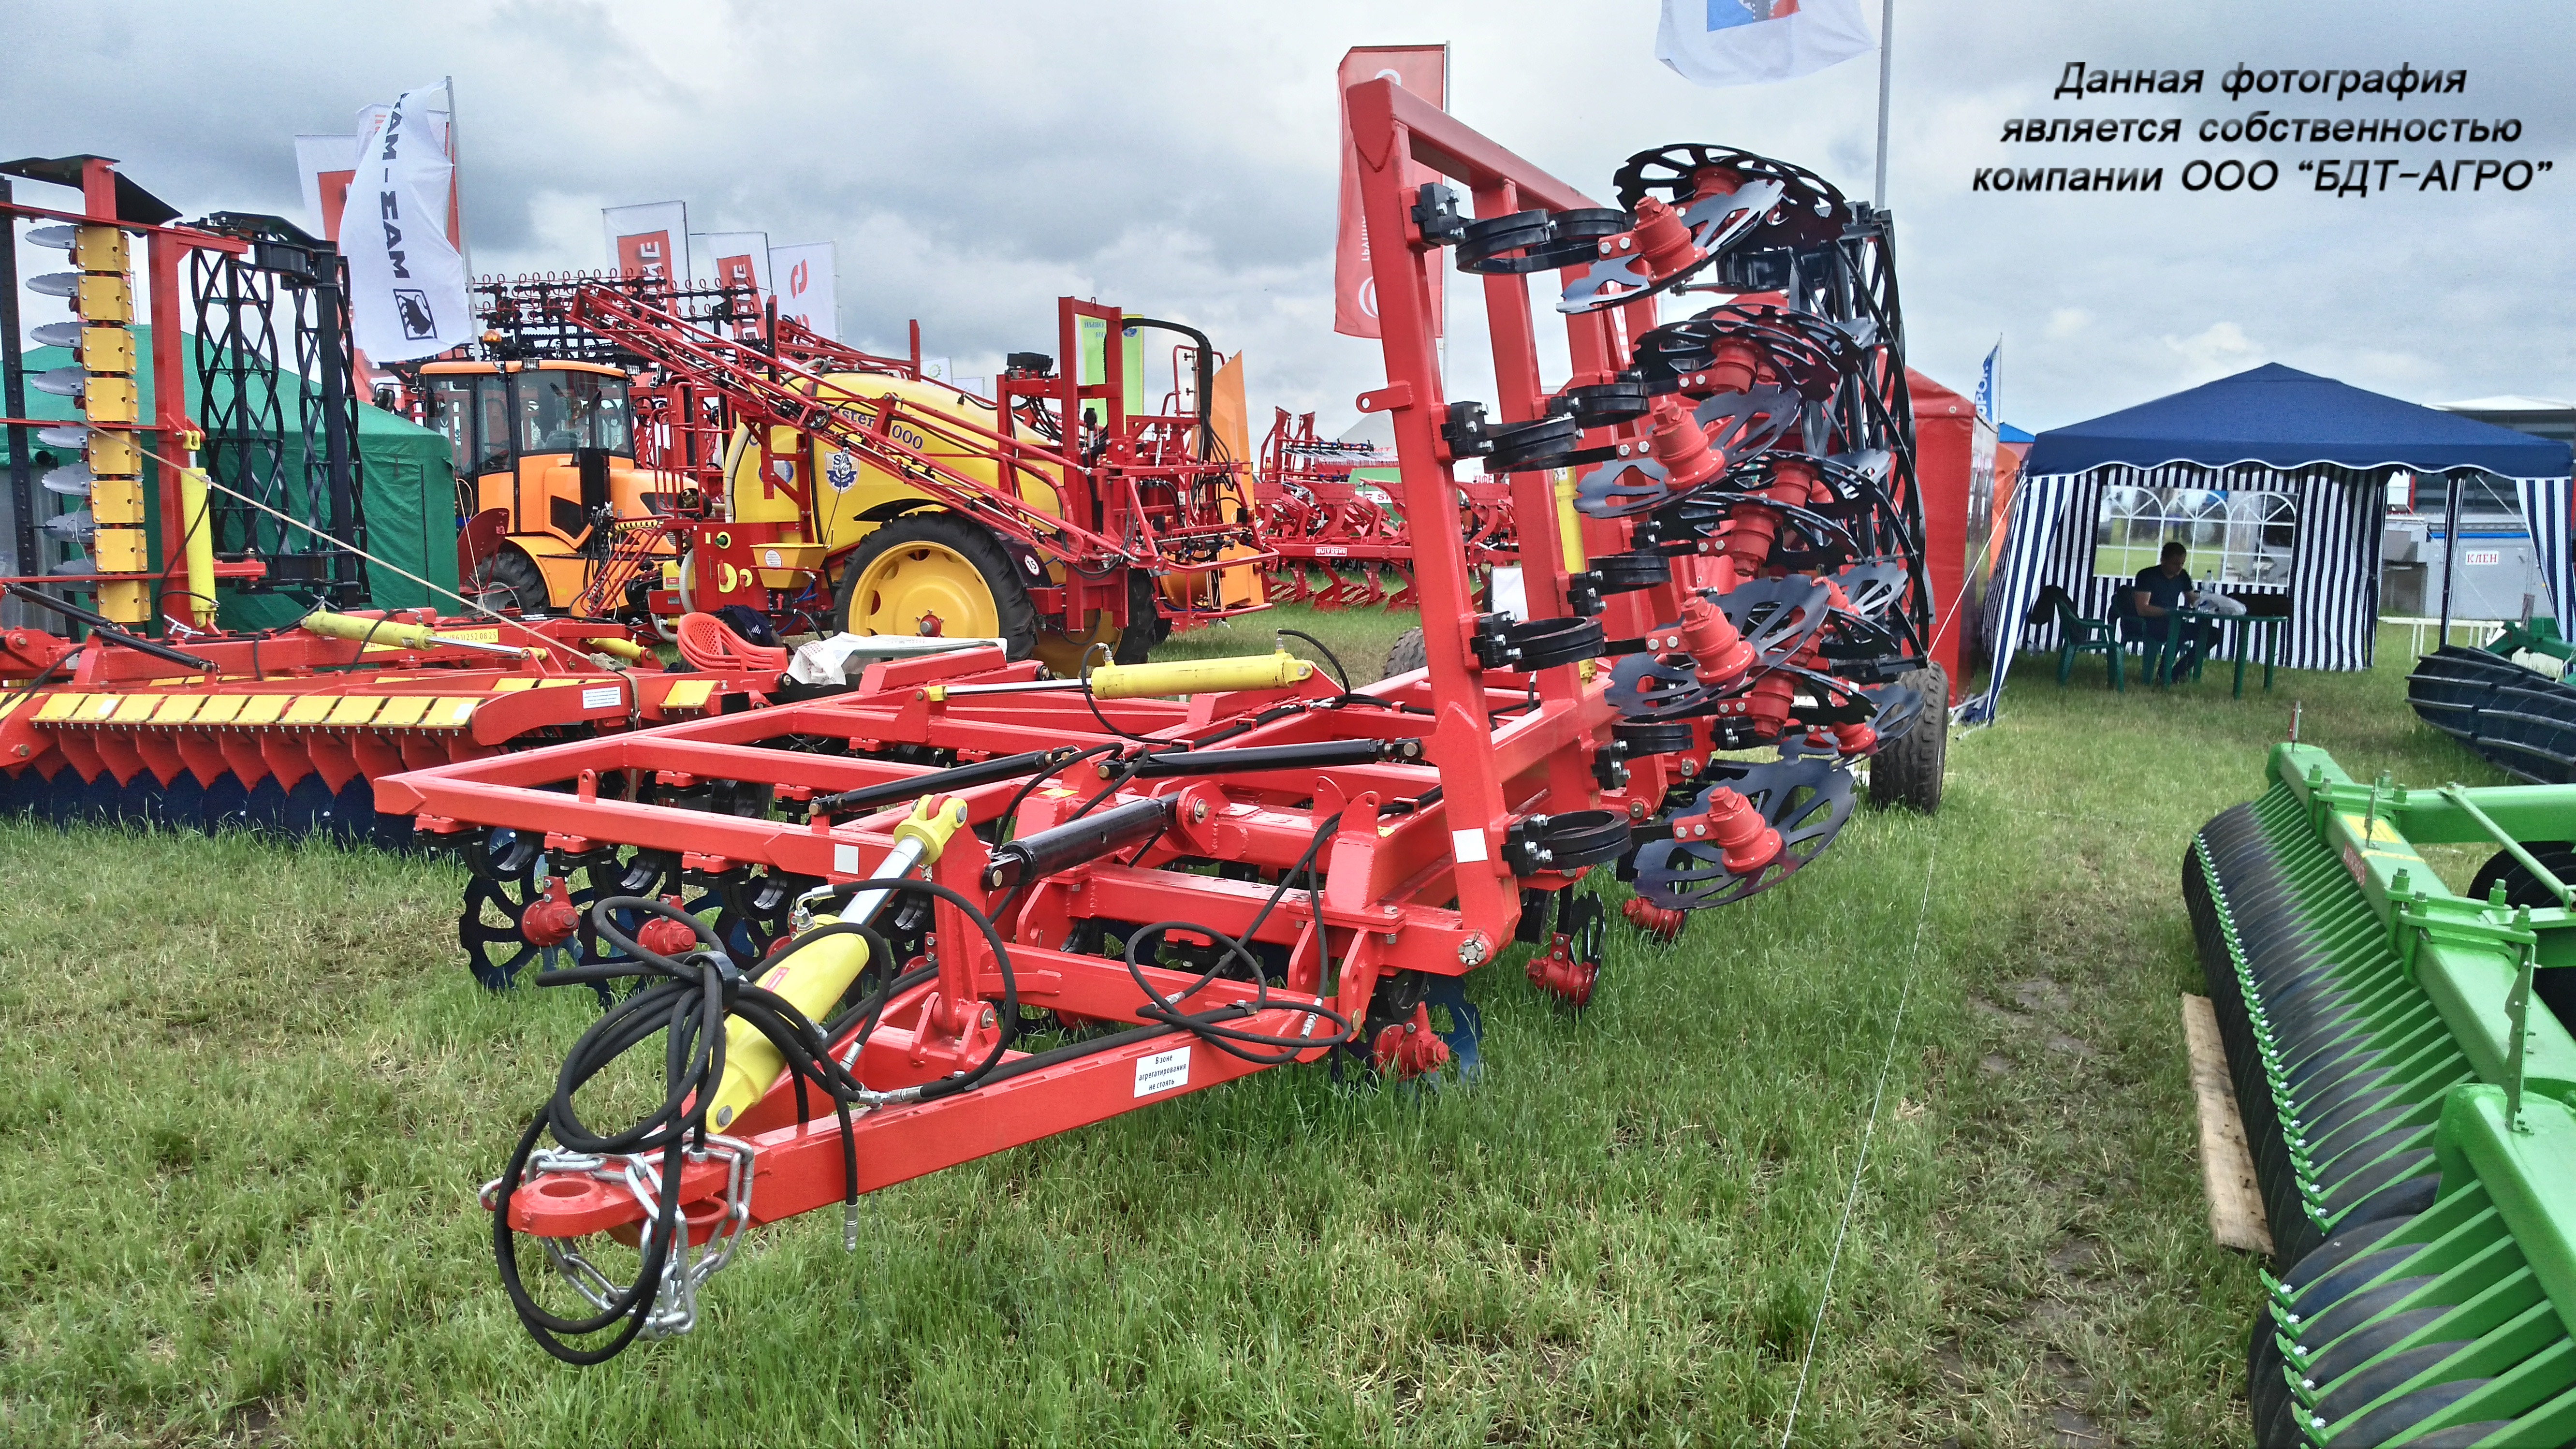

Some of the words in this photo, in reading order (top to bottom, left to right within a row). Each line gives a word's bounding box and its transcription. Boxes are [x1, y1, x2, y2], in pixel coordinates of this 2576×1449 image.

[892, 424, 923, 449] 000
[2467, 554, 2497, 563] КЛЕН
[1026, 560, 1037, 570] 15
[1160, 1055, 1172, 1064] зоне
[1139, 1064, 1186, 1082] агрегатирования
[1156, 1079, 1174, 1088] стоять
